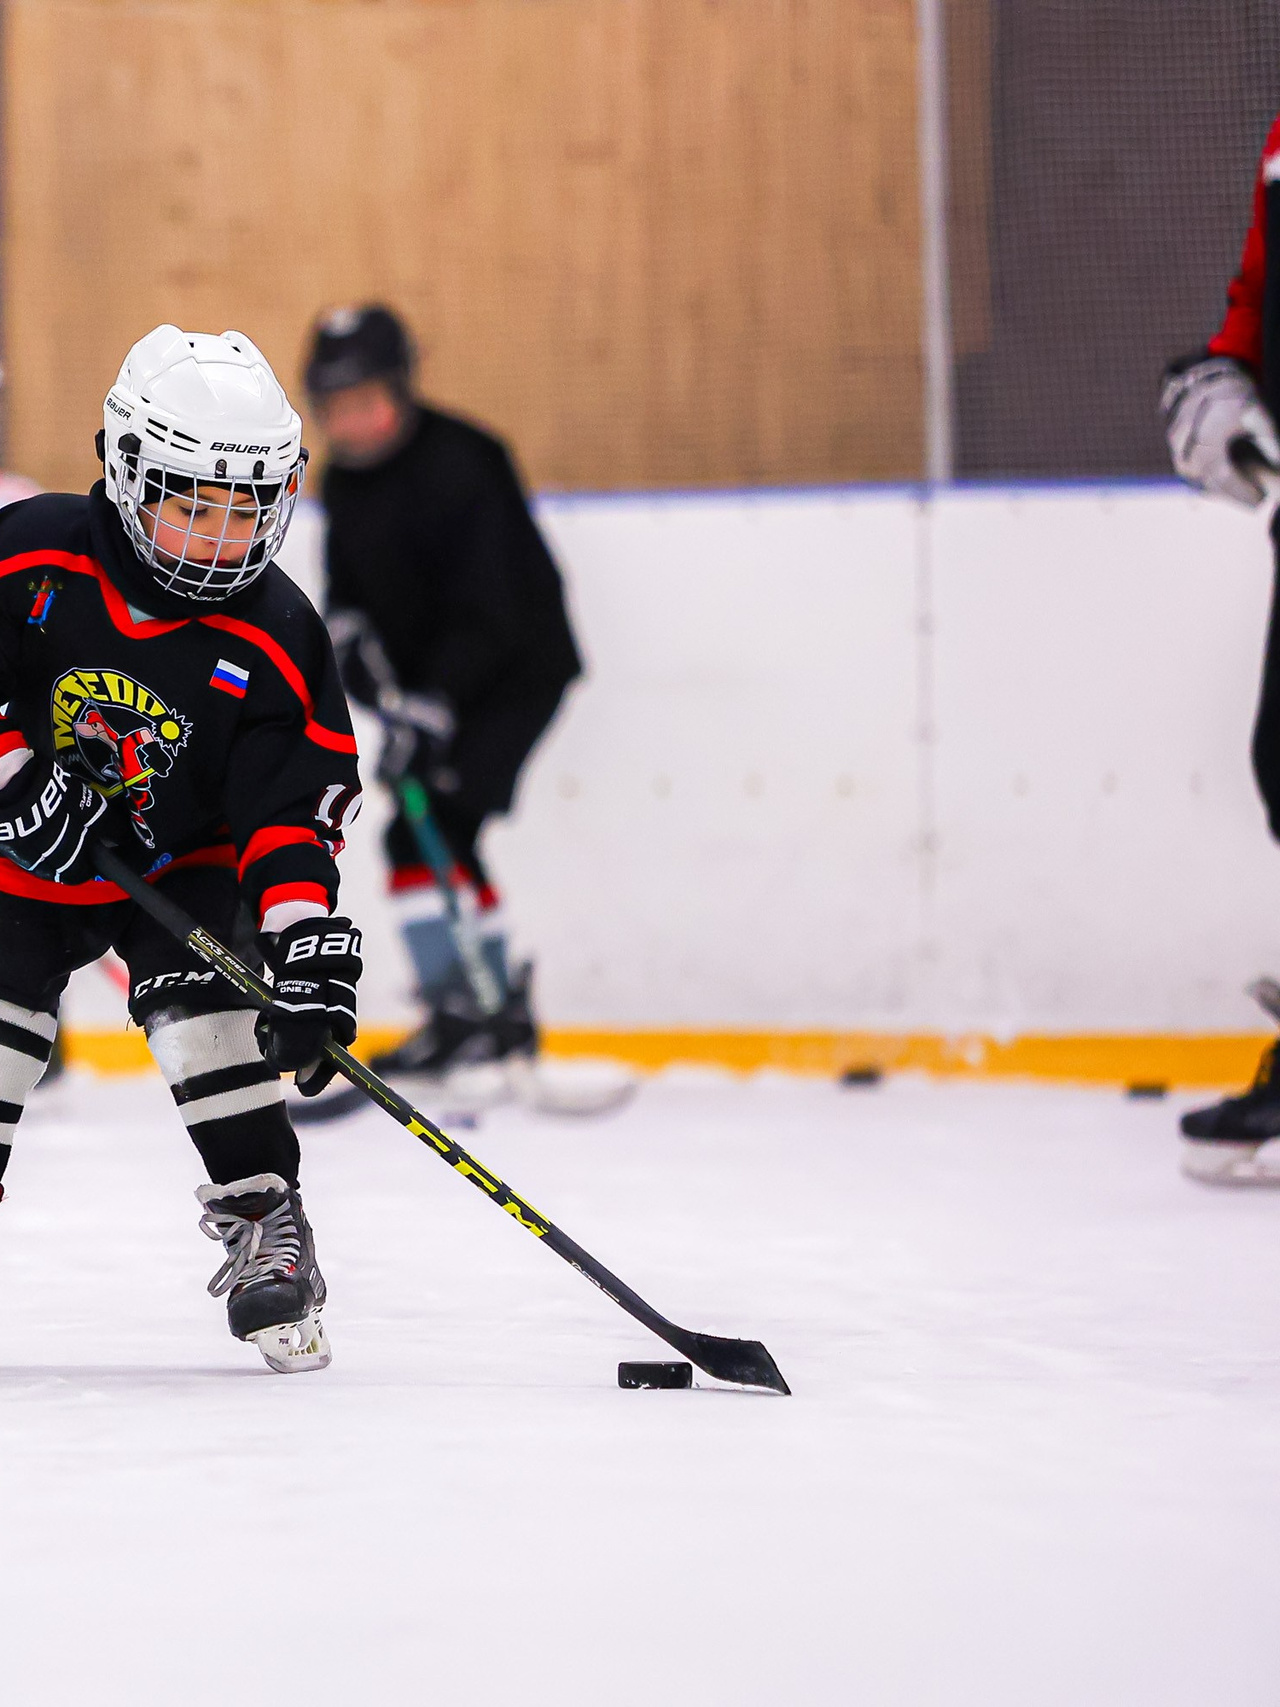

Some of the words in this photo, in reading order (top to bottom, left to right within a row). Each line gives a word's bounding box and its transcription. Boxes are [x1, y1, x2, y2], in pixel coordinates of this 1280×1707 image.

[106, 397, 132, 421] BAUER
[210, 441, 271, 455] BAUER
[134, 971, 216, 999] CCM
[276, 980, 320, 990] SUPREME
[405, 1114, 550, 1238] CCM
